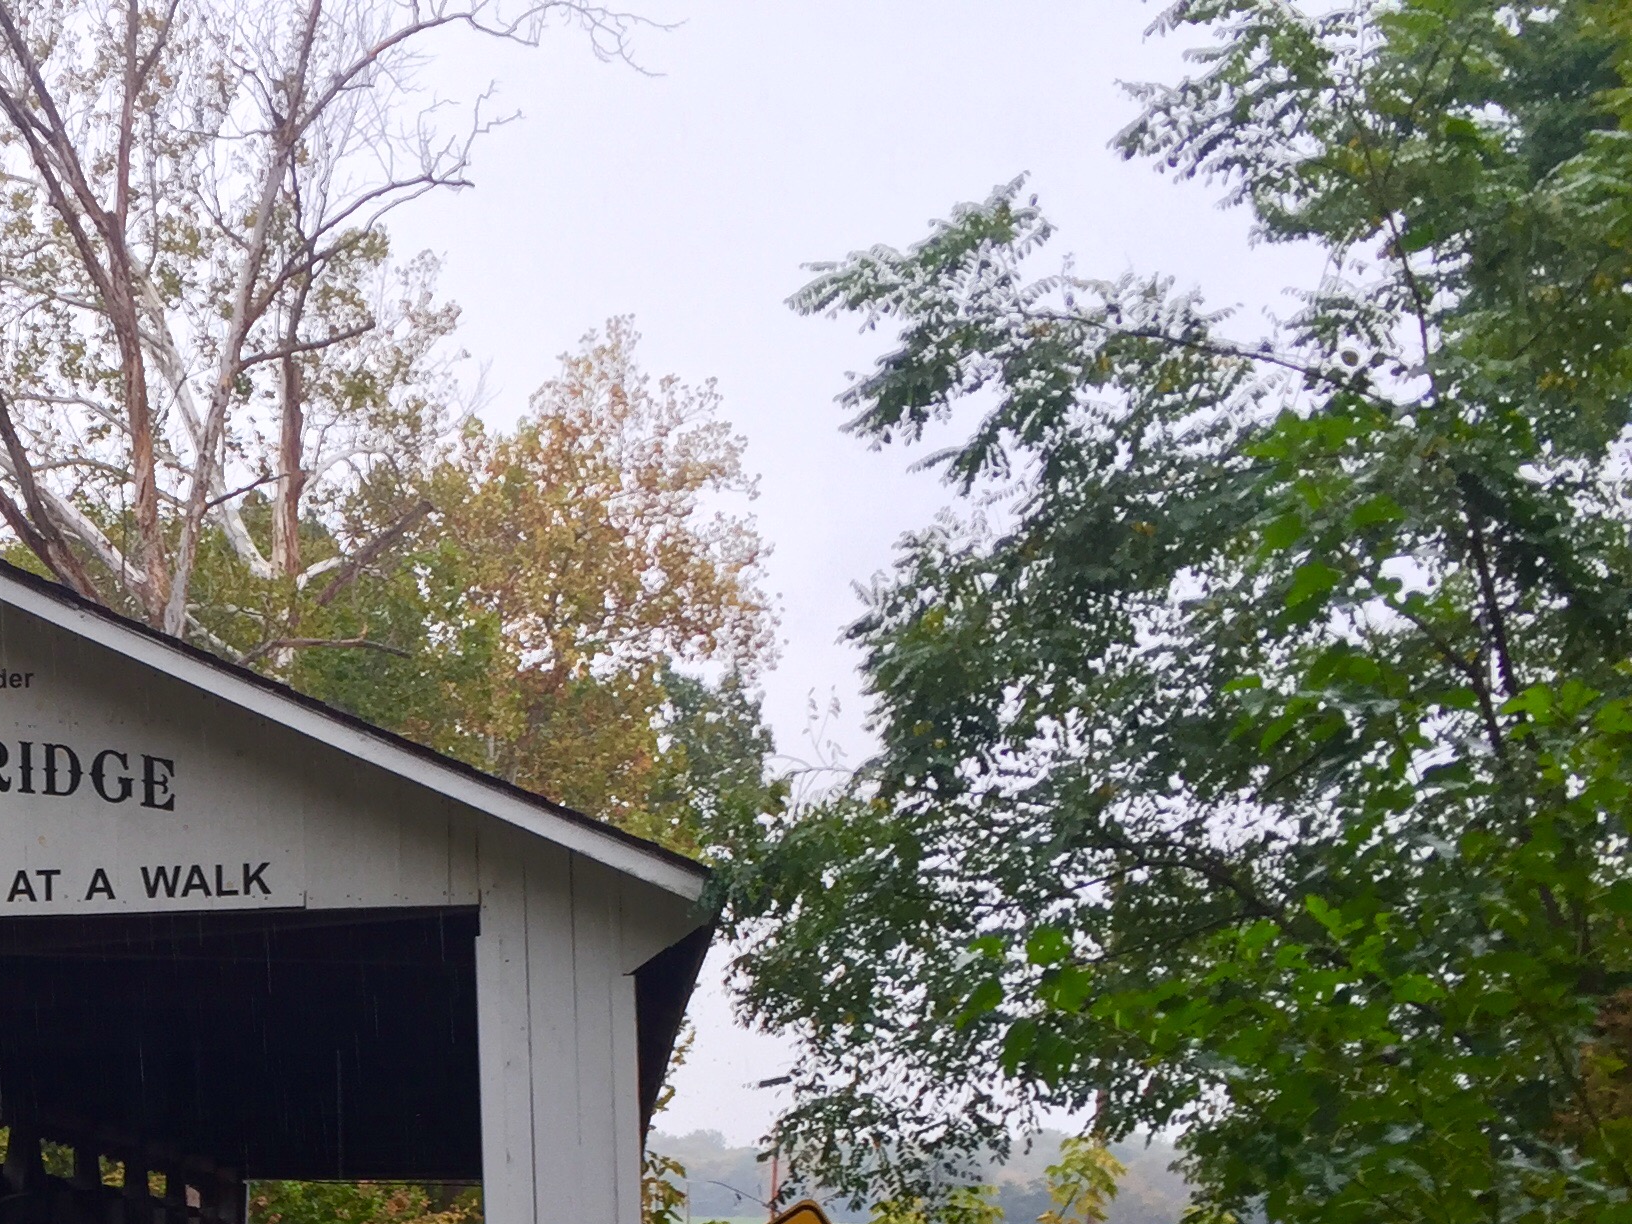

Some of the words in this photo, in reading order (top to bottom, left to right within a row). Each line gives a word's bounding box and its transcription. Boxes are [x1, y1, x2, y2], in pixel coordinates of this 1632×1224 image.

[6, 869, 62, 902] AT
[84, 868, 116, 901] A
[140, 862, 273, 900] WALK
